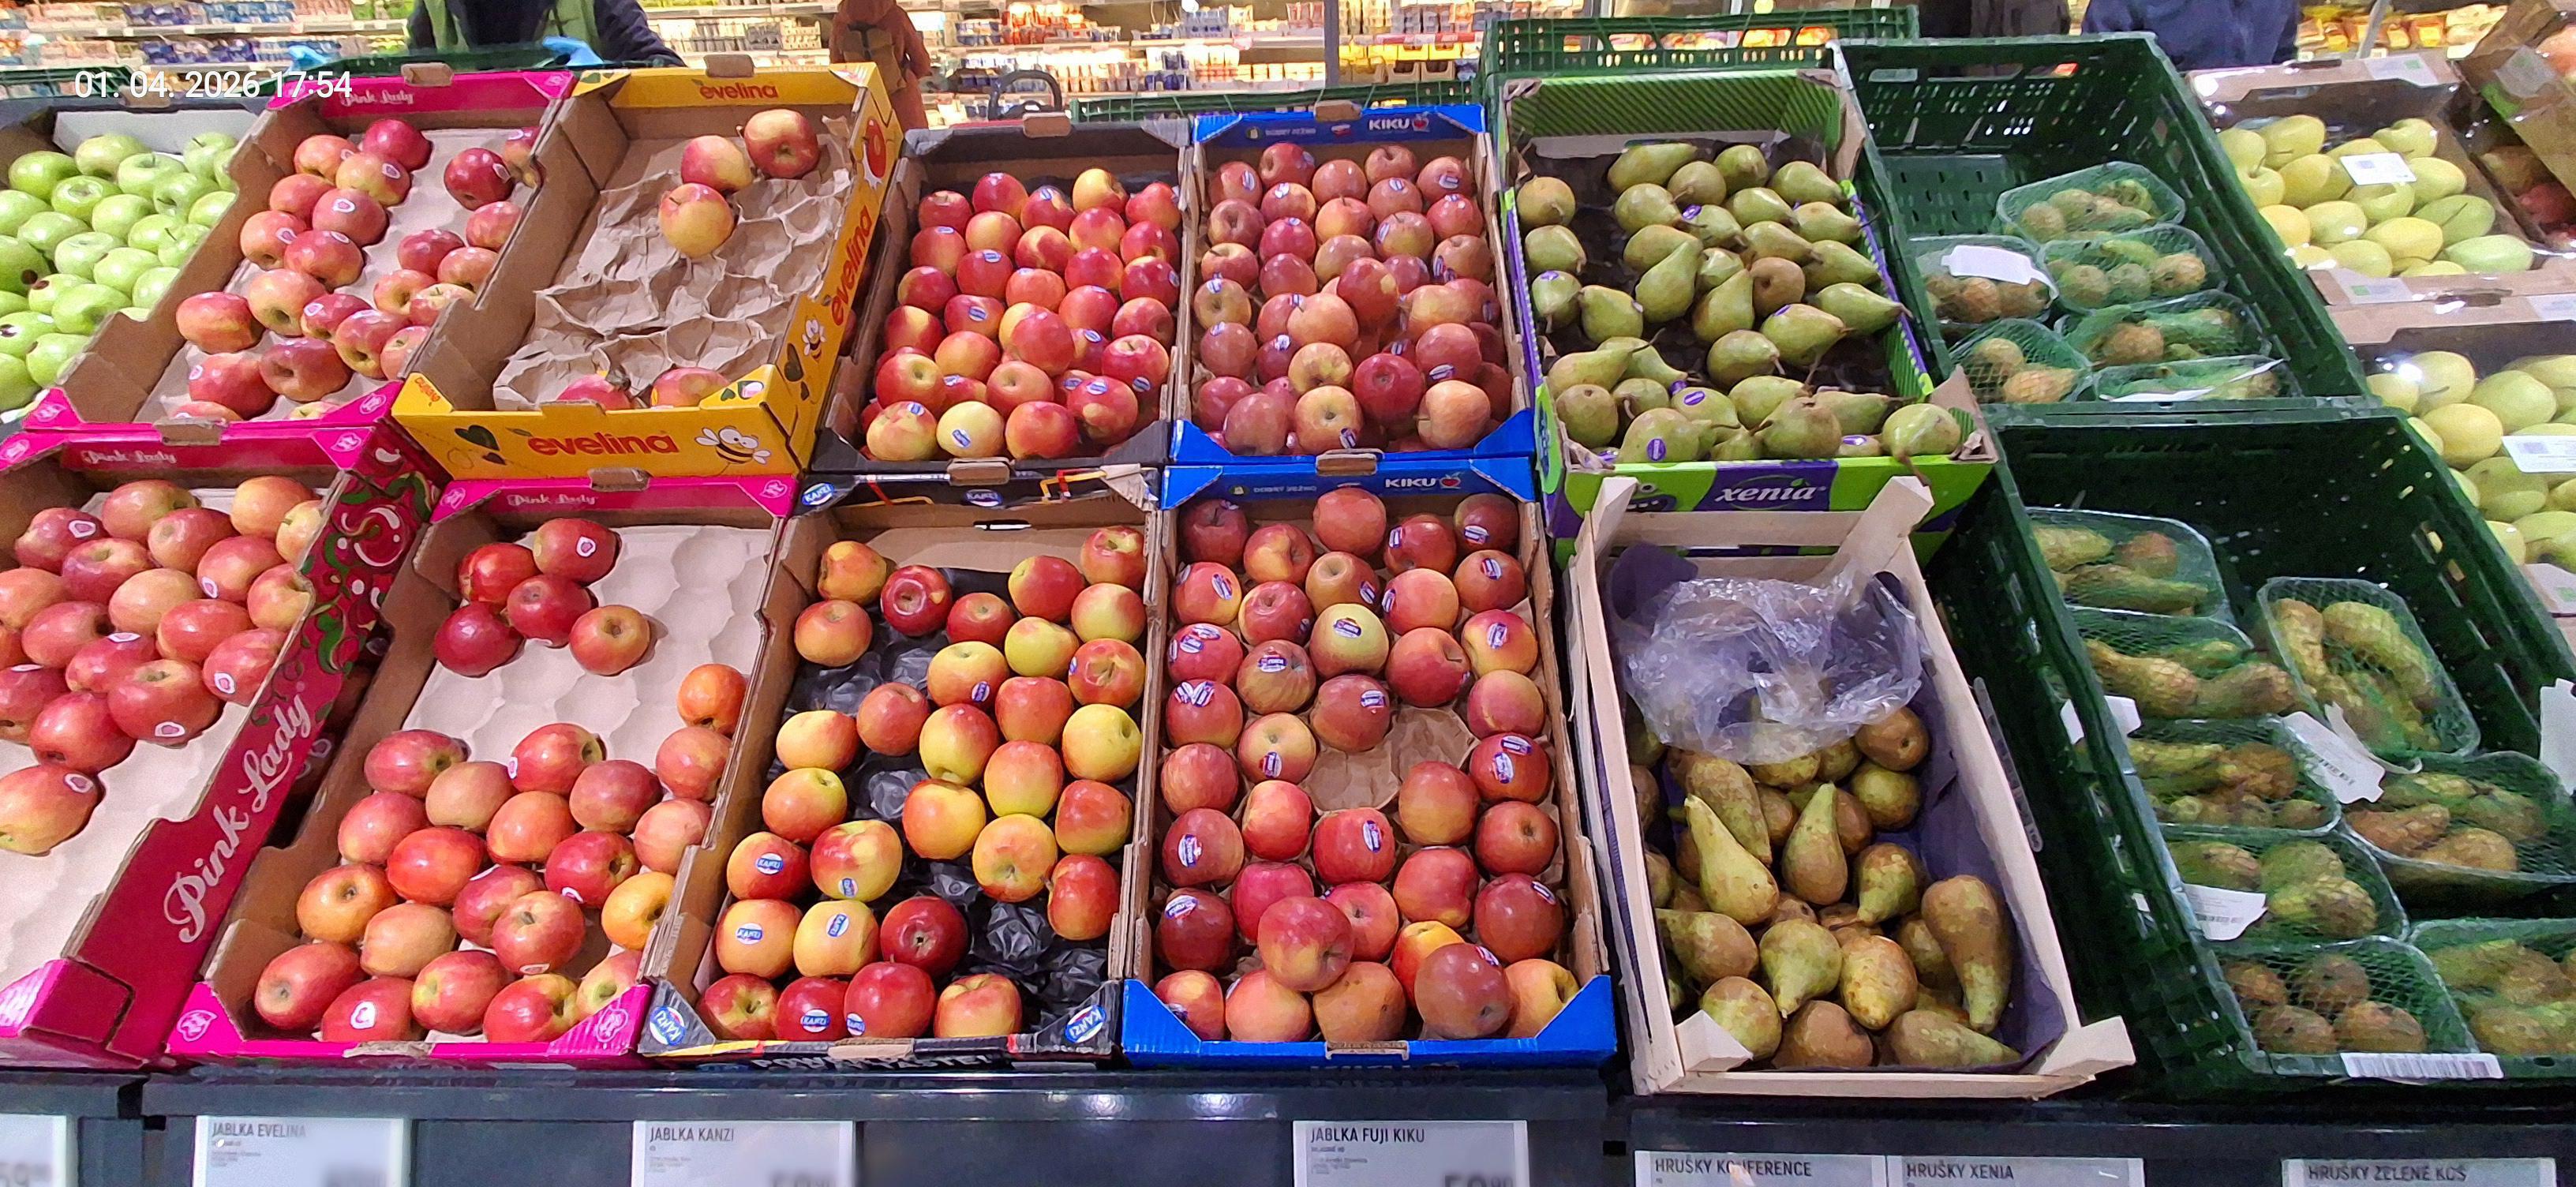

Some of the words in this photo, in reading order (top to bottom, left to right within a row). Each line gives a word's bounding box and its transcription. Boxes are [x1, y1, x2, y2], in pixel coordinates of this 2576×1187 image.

[699, 82, 779, 99] evelina
[1368, 118, 1410, 130] KIKU
[831, 204, 873, 326] evelina
[527, 432, 680, 456] evelina
[804, 483, 832, 503] KANZI
[1385, 477, 1436, 489] KIKU
[1714, 482, 1818, 504] xenia
[163, 804, 249, 944] Pink
[238, 691, 313, 814] Lady
[653, 1009, 683, 1041] KANZI
[1068, 1007, 1103, 1040] KANZI
[212, 1123, 254, 1137] JABLKA
[257, 1123, 307, 1138] EVELINA
[650, 1127, 695, 1142] JABLKA
[698, 1127, 734, 1142] KANZI
[1311, 1128, 1358, 1143] JABLKA
[1363, 1128, 1388, 1144] FUJI
[1394, 1128, 1425, 1143] KIKU
[1907, 1159, 1965, 1179] HRUŠKY
[1970, 1163, 2014, 1180] XENIA
